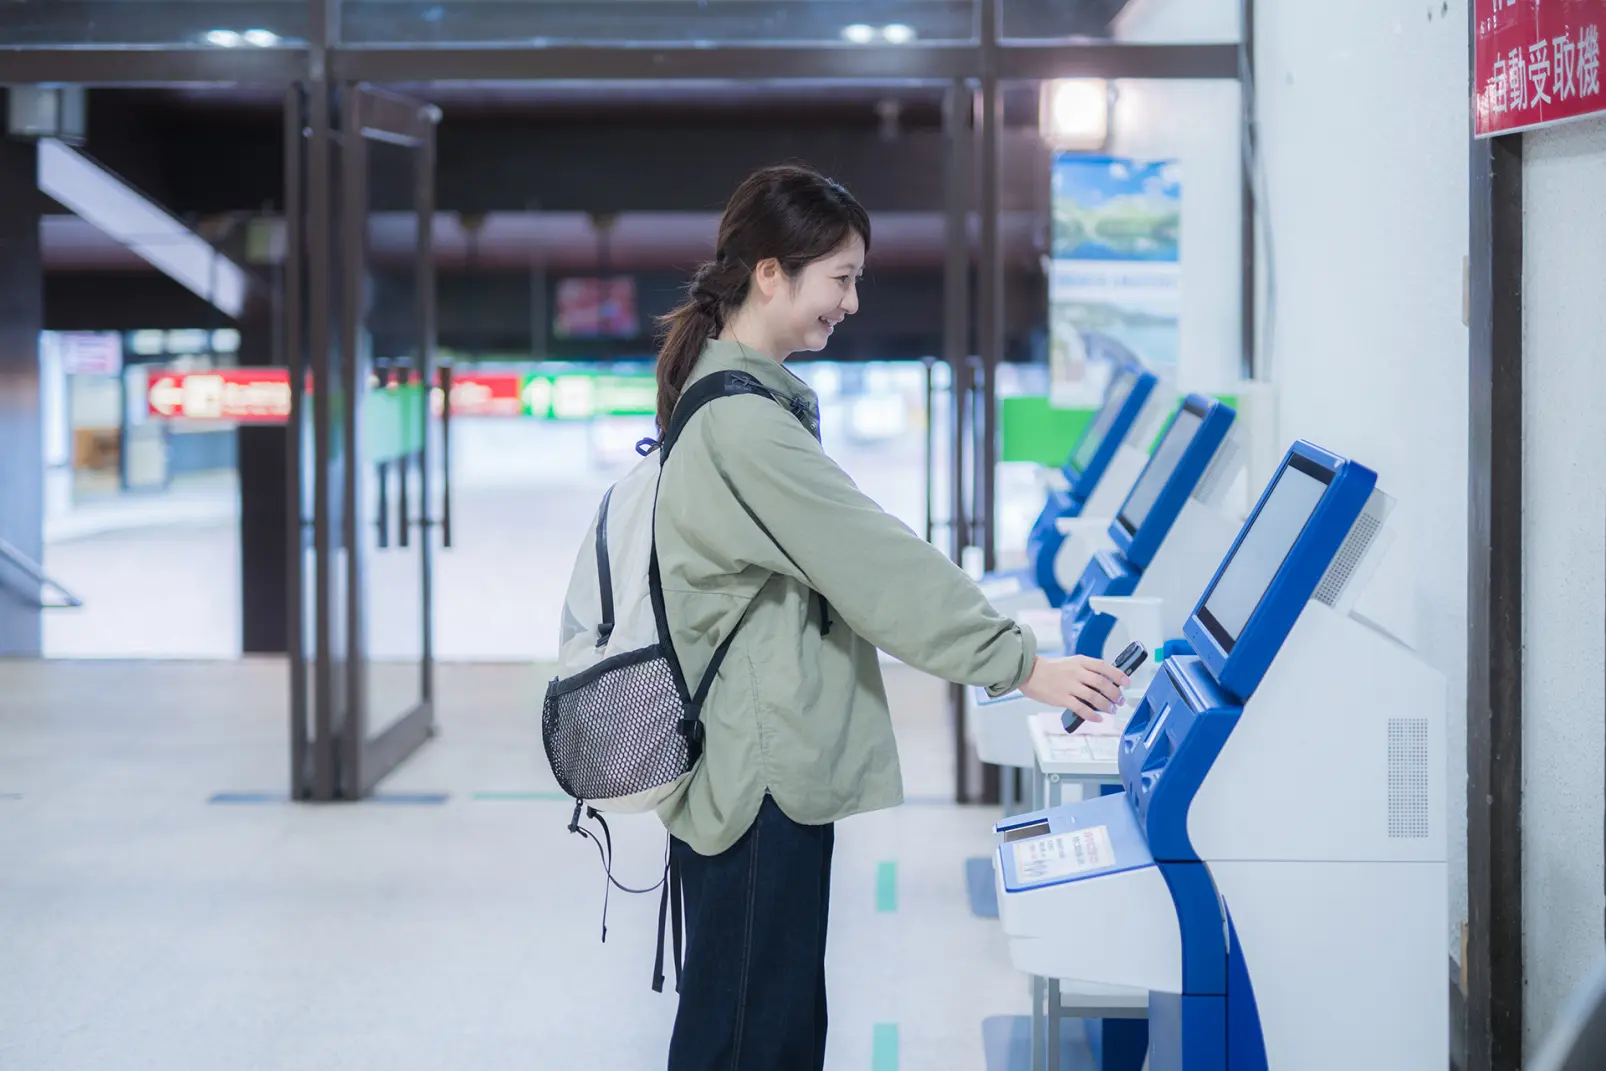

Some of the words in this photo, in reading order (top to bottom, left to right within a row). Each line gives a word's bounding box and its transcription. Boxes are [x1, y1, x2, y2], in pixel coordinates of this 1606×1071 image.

[1493, 24, 1599, 113] 自動受取機
